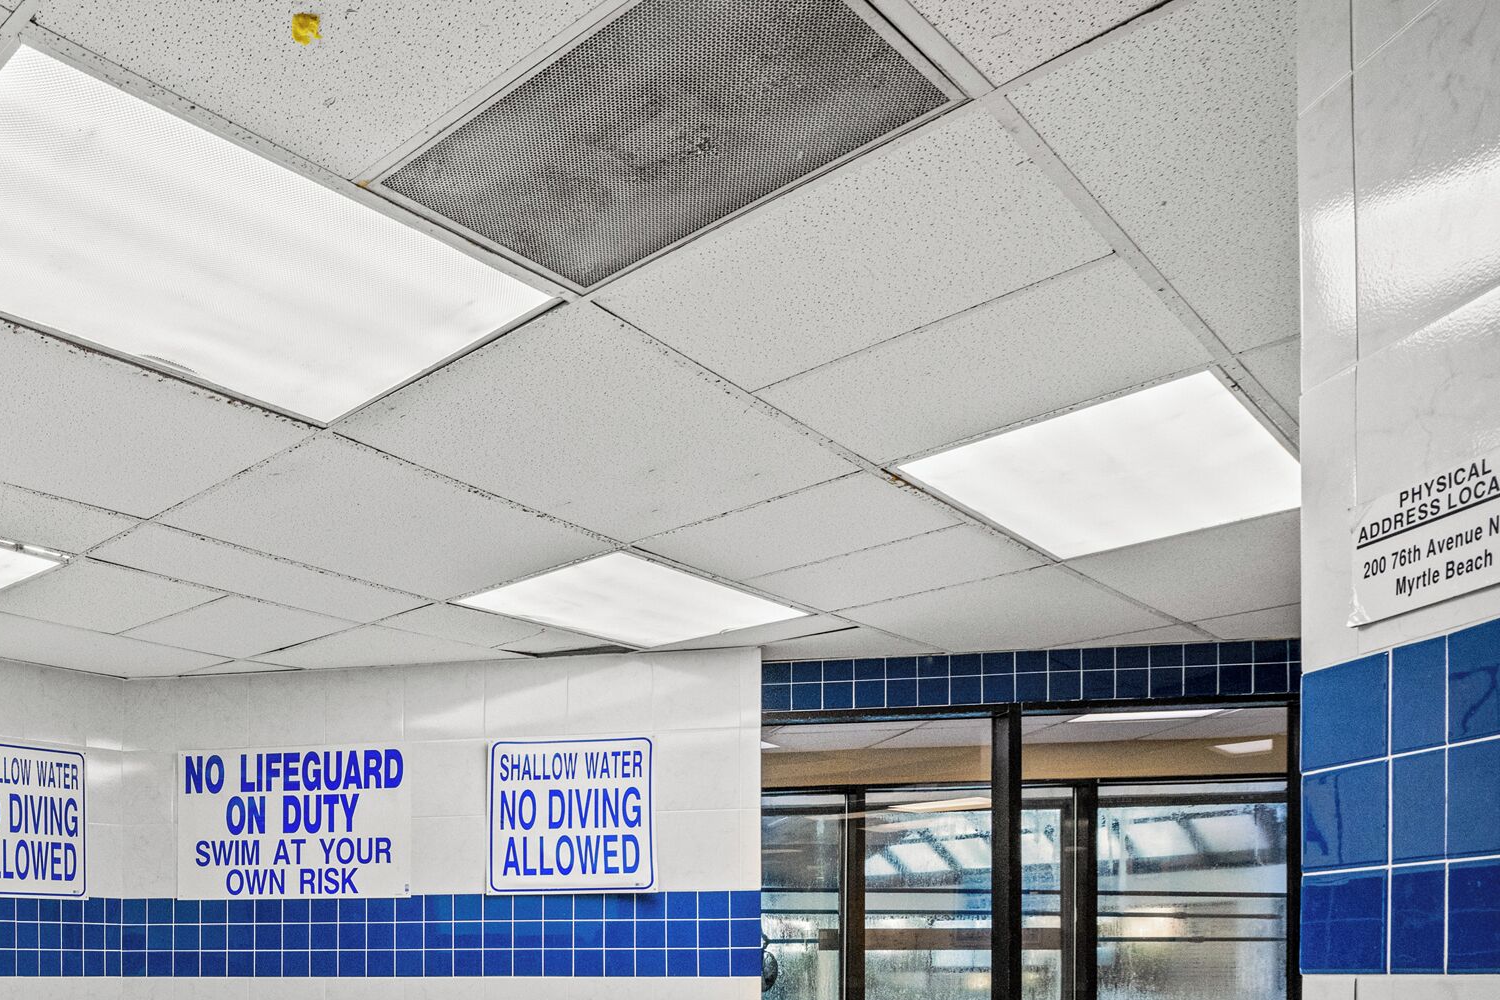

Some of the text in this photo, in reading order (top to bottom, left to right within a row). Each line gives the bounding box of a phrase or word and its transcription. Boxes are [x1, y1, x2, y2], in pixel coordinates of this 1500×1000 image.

[1399, 459, 1492, 507] PHYSICAL
[1358, 498, 1440, 543] ADDRESS
[1364, 556, 1386, 579] 200
[1392, 545, 1421, 569] 76th
[1427, 527, 1482, 558] Avenue
[1396, 549, 1493, 596] Myrtle Beach
[37, 761, 79, 790] WATER
[185, 749, 404, 794] NO LIFEGUARD
[500, 751, 642, 781] SHALLOW WATER
[10, 794, 78, 837] DIVING
[226, 794, 359, 835] ON DUTY
[500, 787, 641, 830] NO DIVING
[195, 837, 392, 866] SWIM AT YOUR
[503, 834, 640, 876] ALLOWED
[226, 867, 358, 895] OWN RISK
